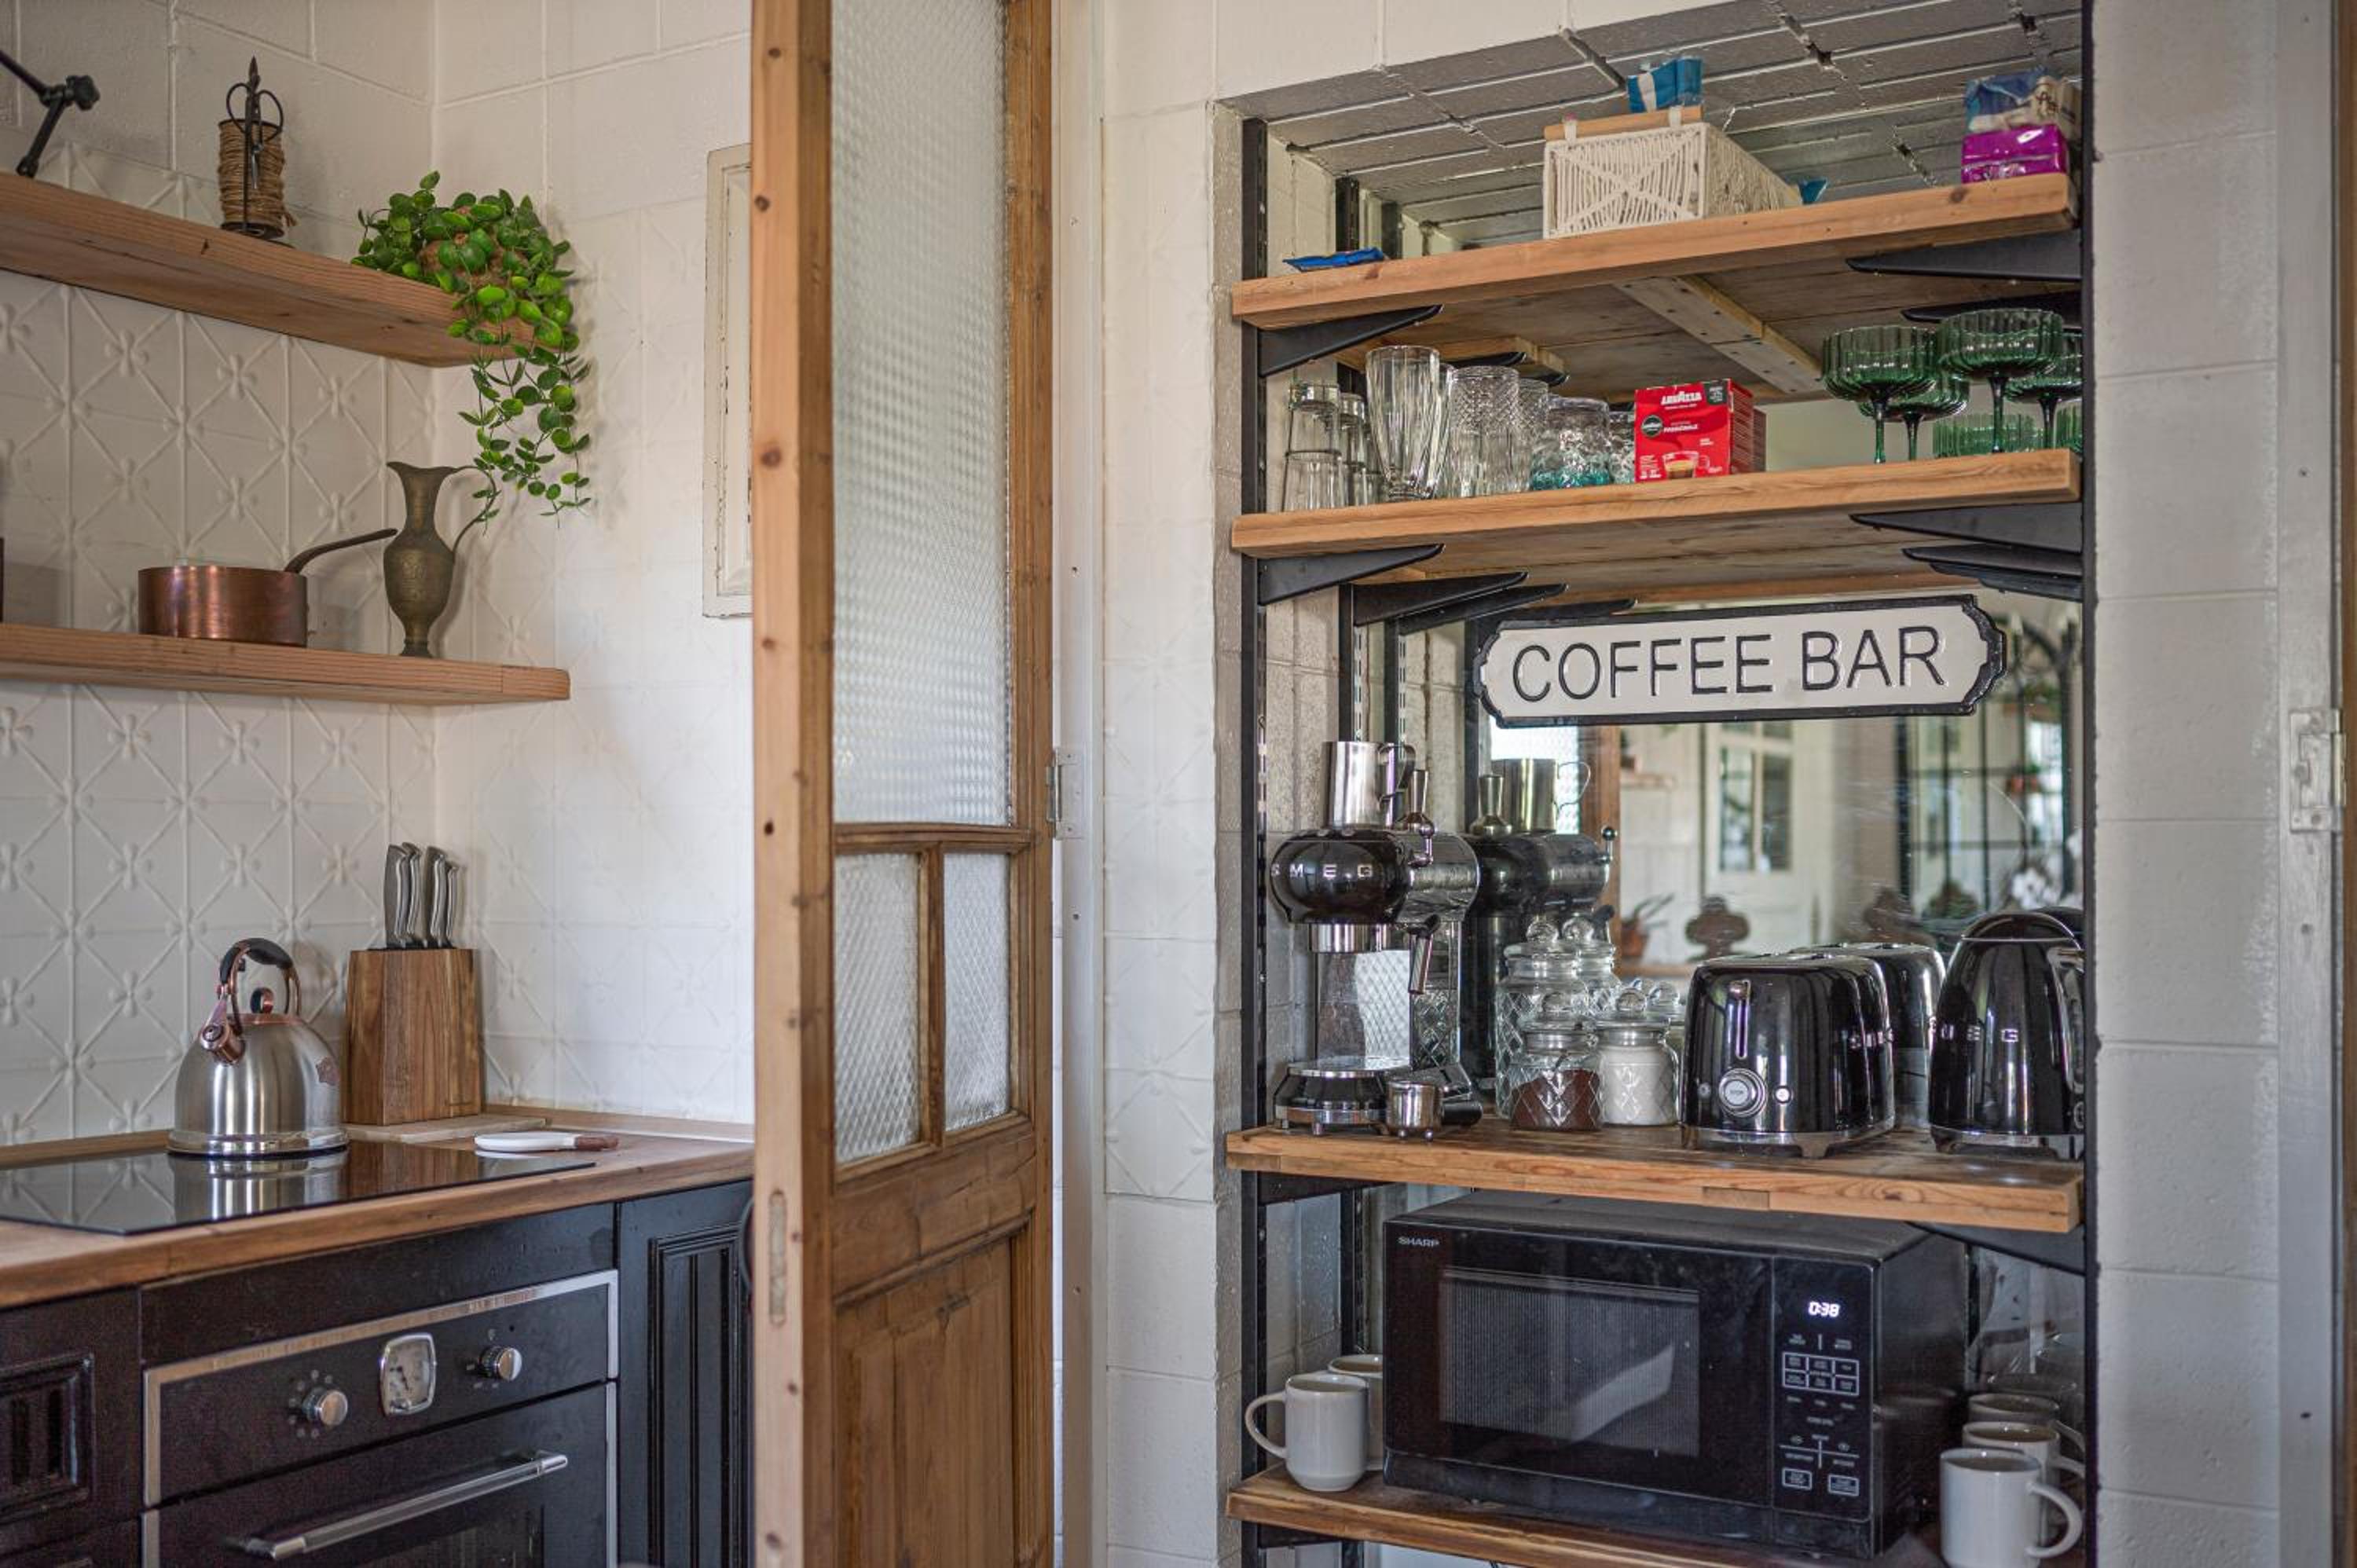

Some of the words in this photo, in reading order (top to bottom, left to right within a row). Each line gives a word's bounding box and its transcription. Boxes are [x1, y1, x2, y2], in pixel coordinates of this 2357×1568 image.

[1512, 634, 1772, 702] COFFEE
[1801, 626, 1947, 691] BAR
[1270, 863, 1373, 878] SMEG
[1398, 1236, 1439, 1247] SHARP
